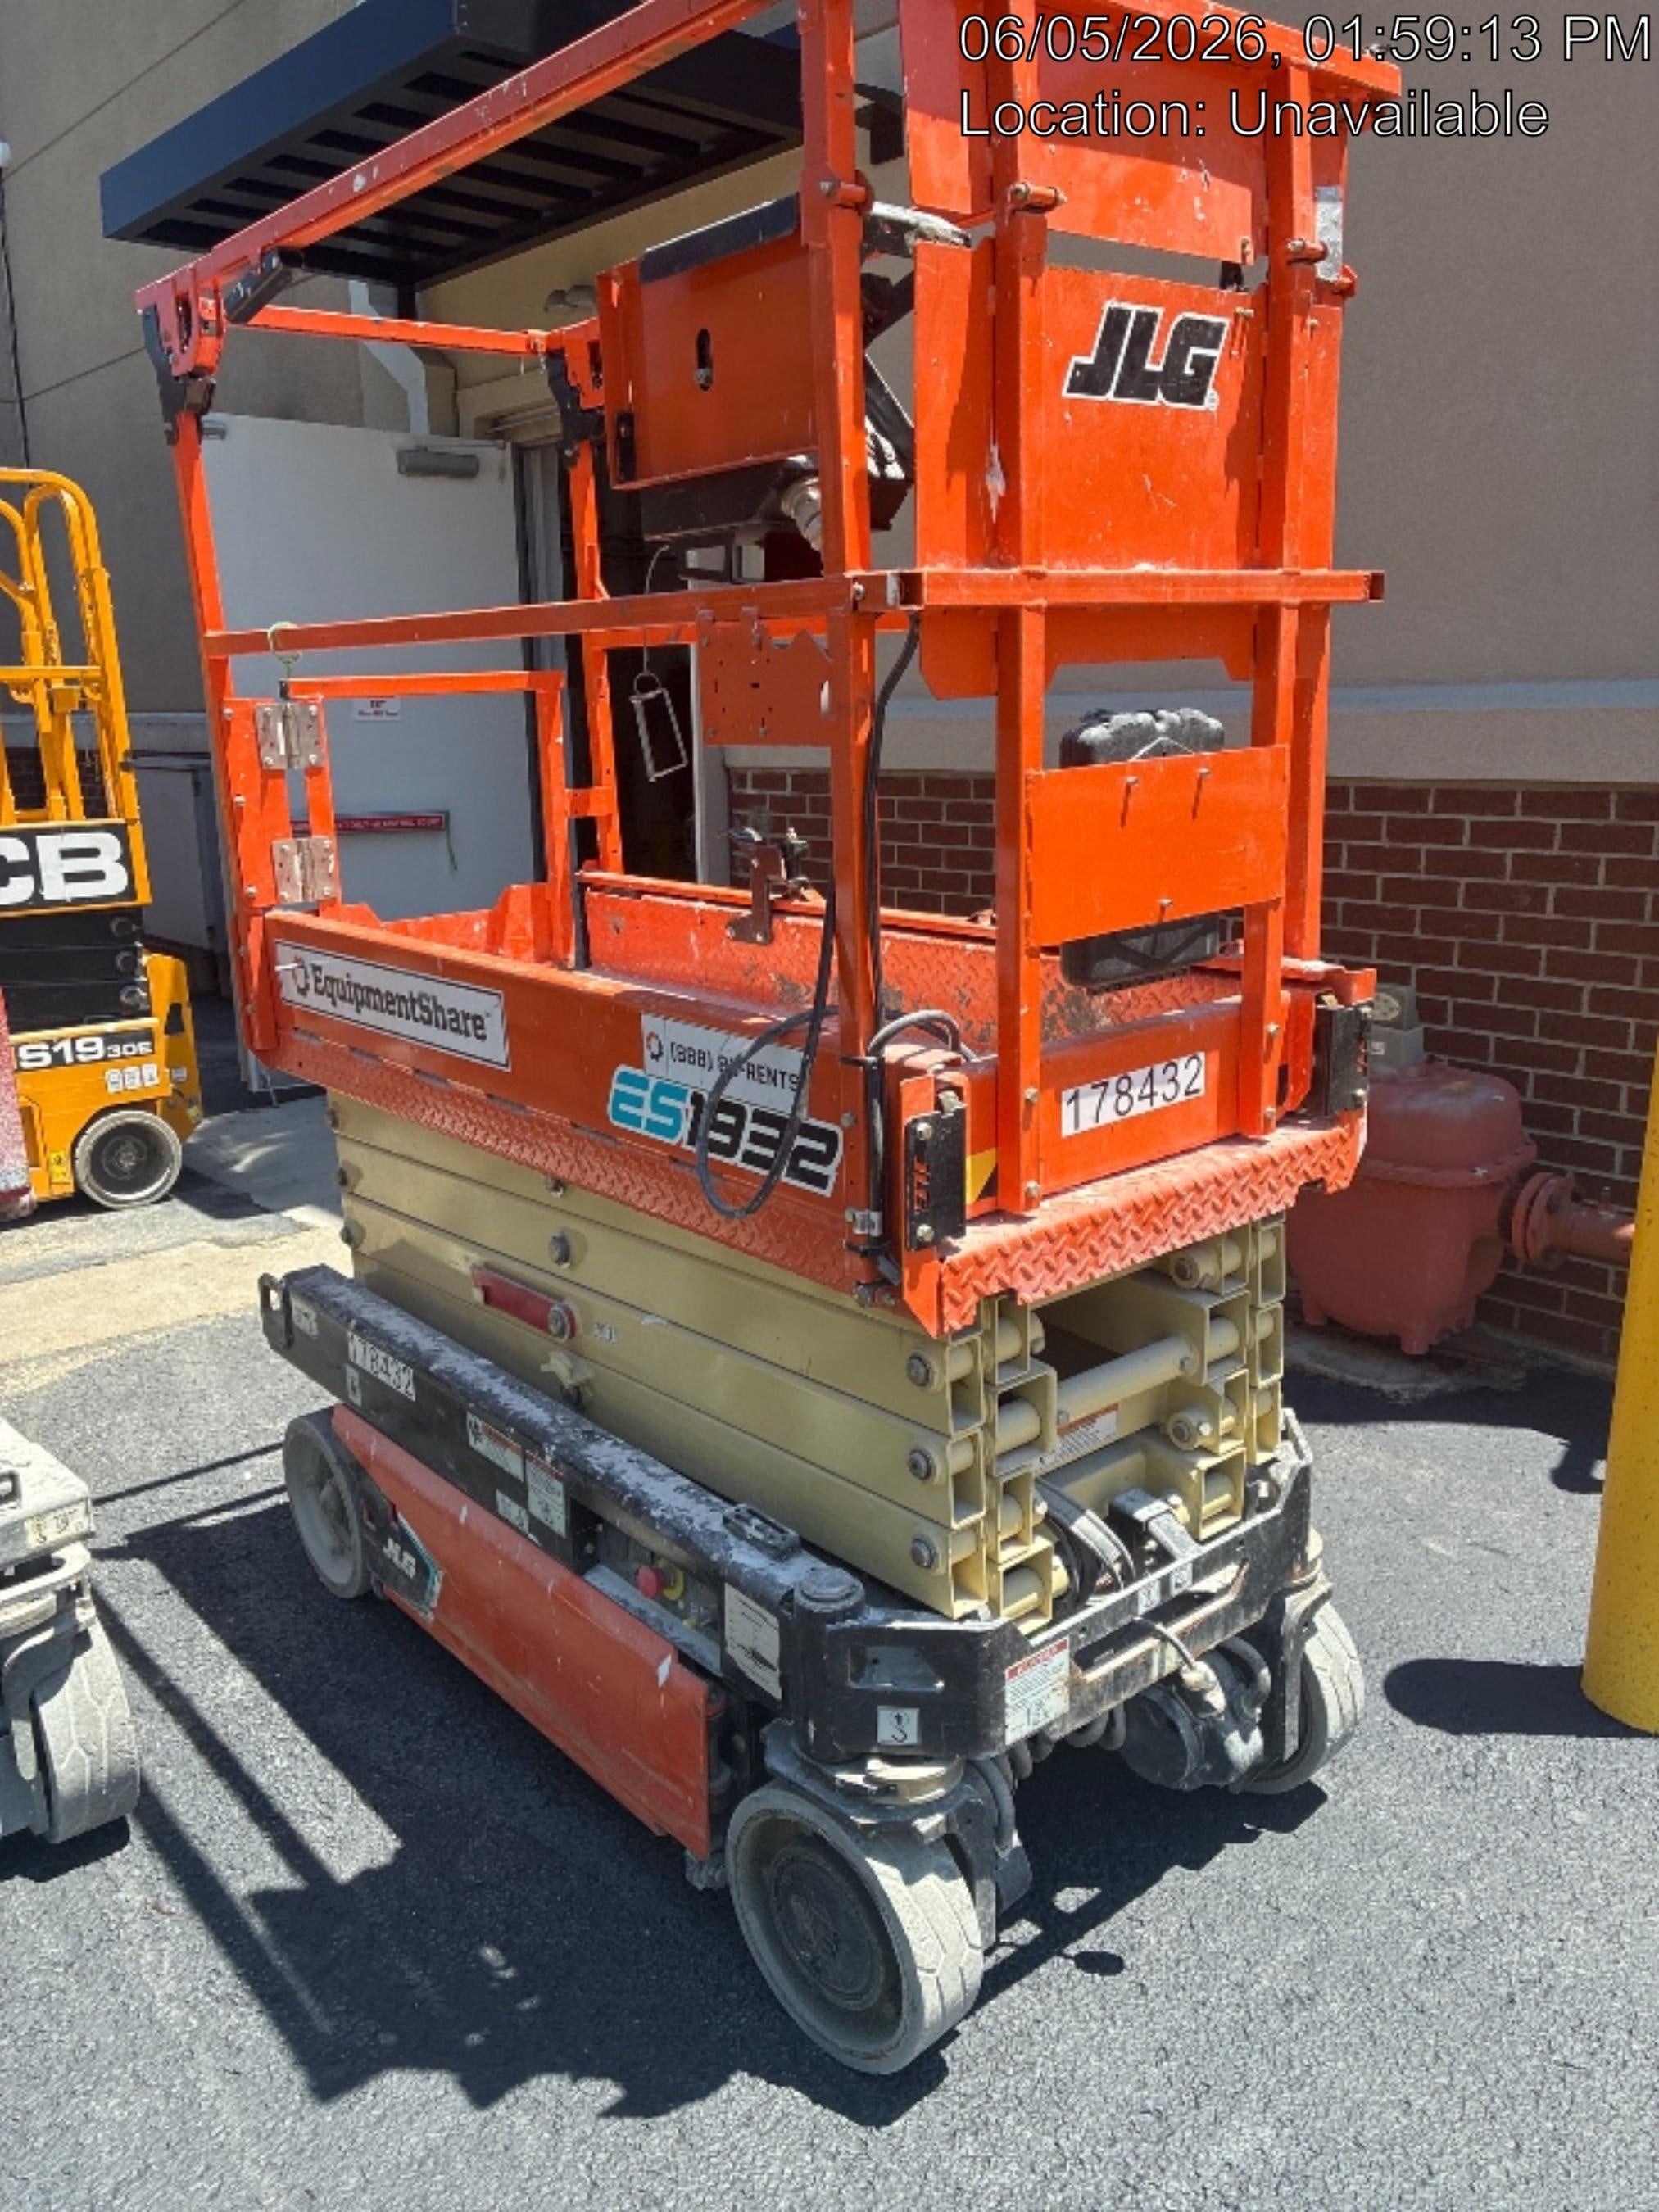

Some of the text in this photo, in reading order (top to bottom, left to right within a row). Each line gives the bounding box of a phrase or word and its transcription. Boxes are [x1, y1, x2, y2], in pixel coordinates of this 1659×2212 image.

[1063, 300, 1230, 410] JLG
[310, 963, 489, 1042] EquipmentShare
[609, 1064, 843, 1196] ES1932
[1065, 1054, 1204, 1133] 178432
[383, 1538, 416, 1579] JLG
